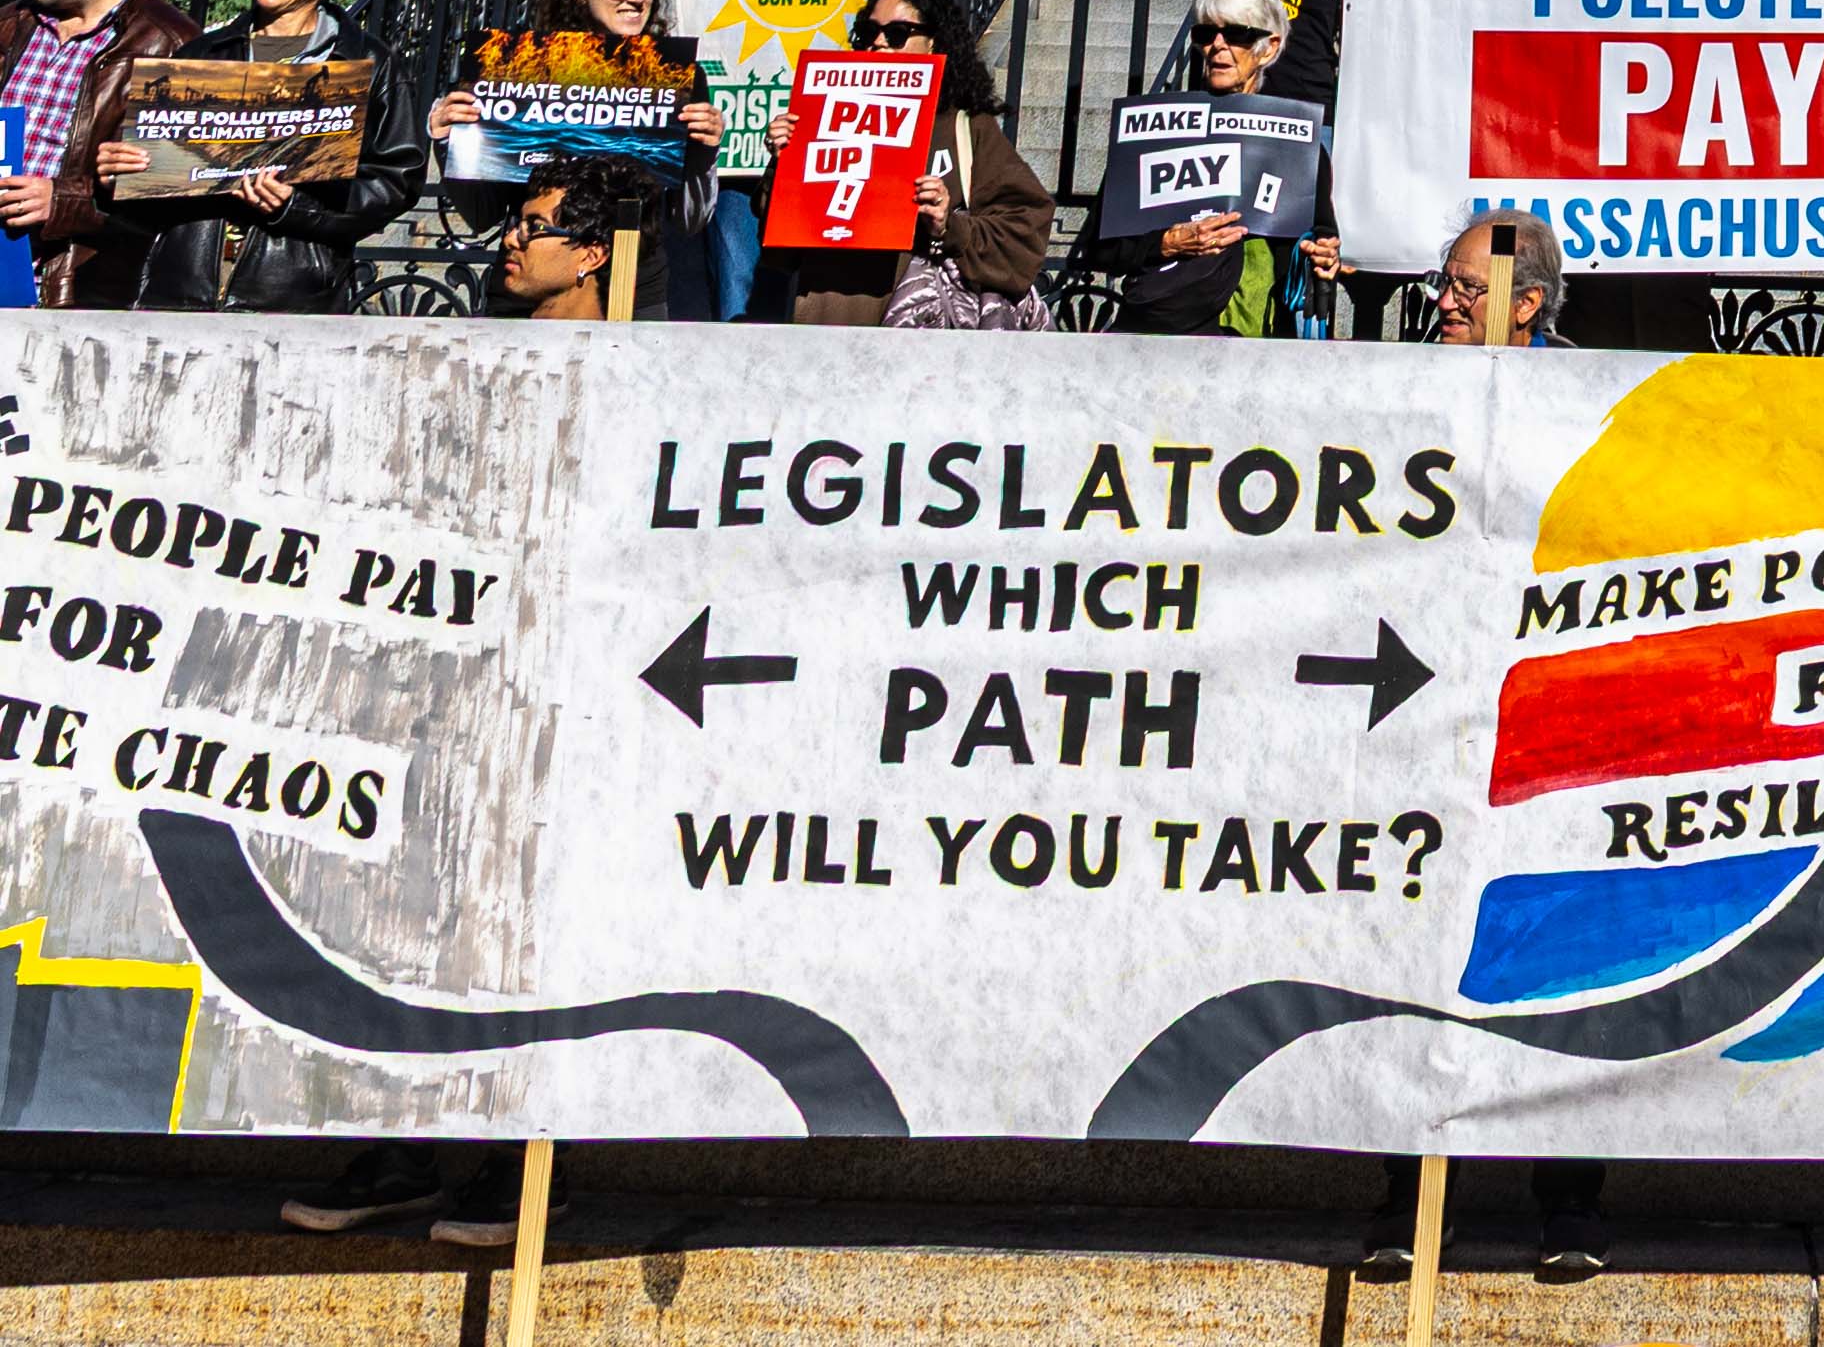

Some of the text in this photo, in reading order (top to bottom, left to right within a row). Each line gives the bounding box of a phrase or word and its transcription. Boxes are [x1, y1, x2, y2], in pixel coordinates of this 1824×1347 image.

[473, 80, 676, 105] CLIMATE CHANGE IS
[813, 69, 923, 88] POLLUTERS
[136, 119, 354, 140] TEXT CLIMATE TO 67369
[137, 105, 356, 126] MAKE POLLUTERS PAY
[472, 98, 675, 128] NO ACCIDENT
[828, 101, 912, 137] PAY
[1125, 110, 1310, 137] MAKE POLLUTERS
[815, 147, 863, 174] UP
[1150, 154, 1230, 195] PAY
[838, 185, 855, 212] !
[1262, 182, 1274, 204] !
[649, 437, 1457, 541] LEGISLATORS
[5, 475, 498, 625] PEOPLE PAY
[901, 561, 1201, 633] WHICH
[1514, 557, 1732, 642] MAKE
[0, 585, 163, 673] FOR
[880, 667, 1201, 769] PATH
[113, 727, 385, 840] CHAOS
[675, 810, 1443, 901] WILL YOU TAKE?
